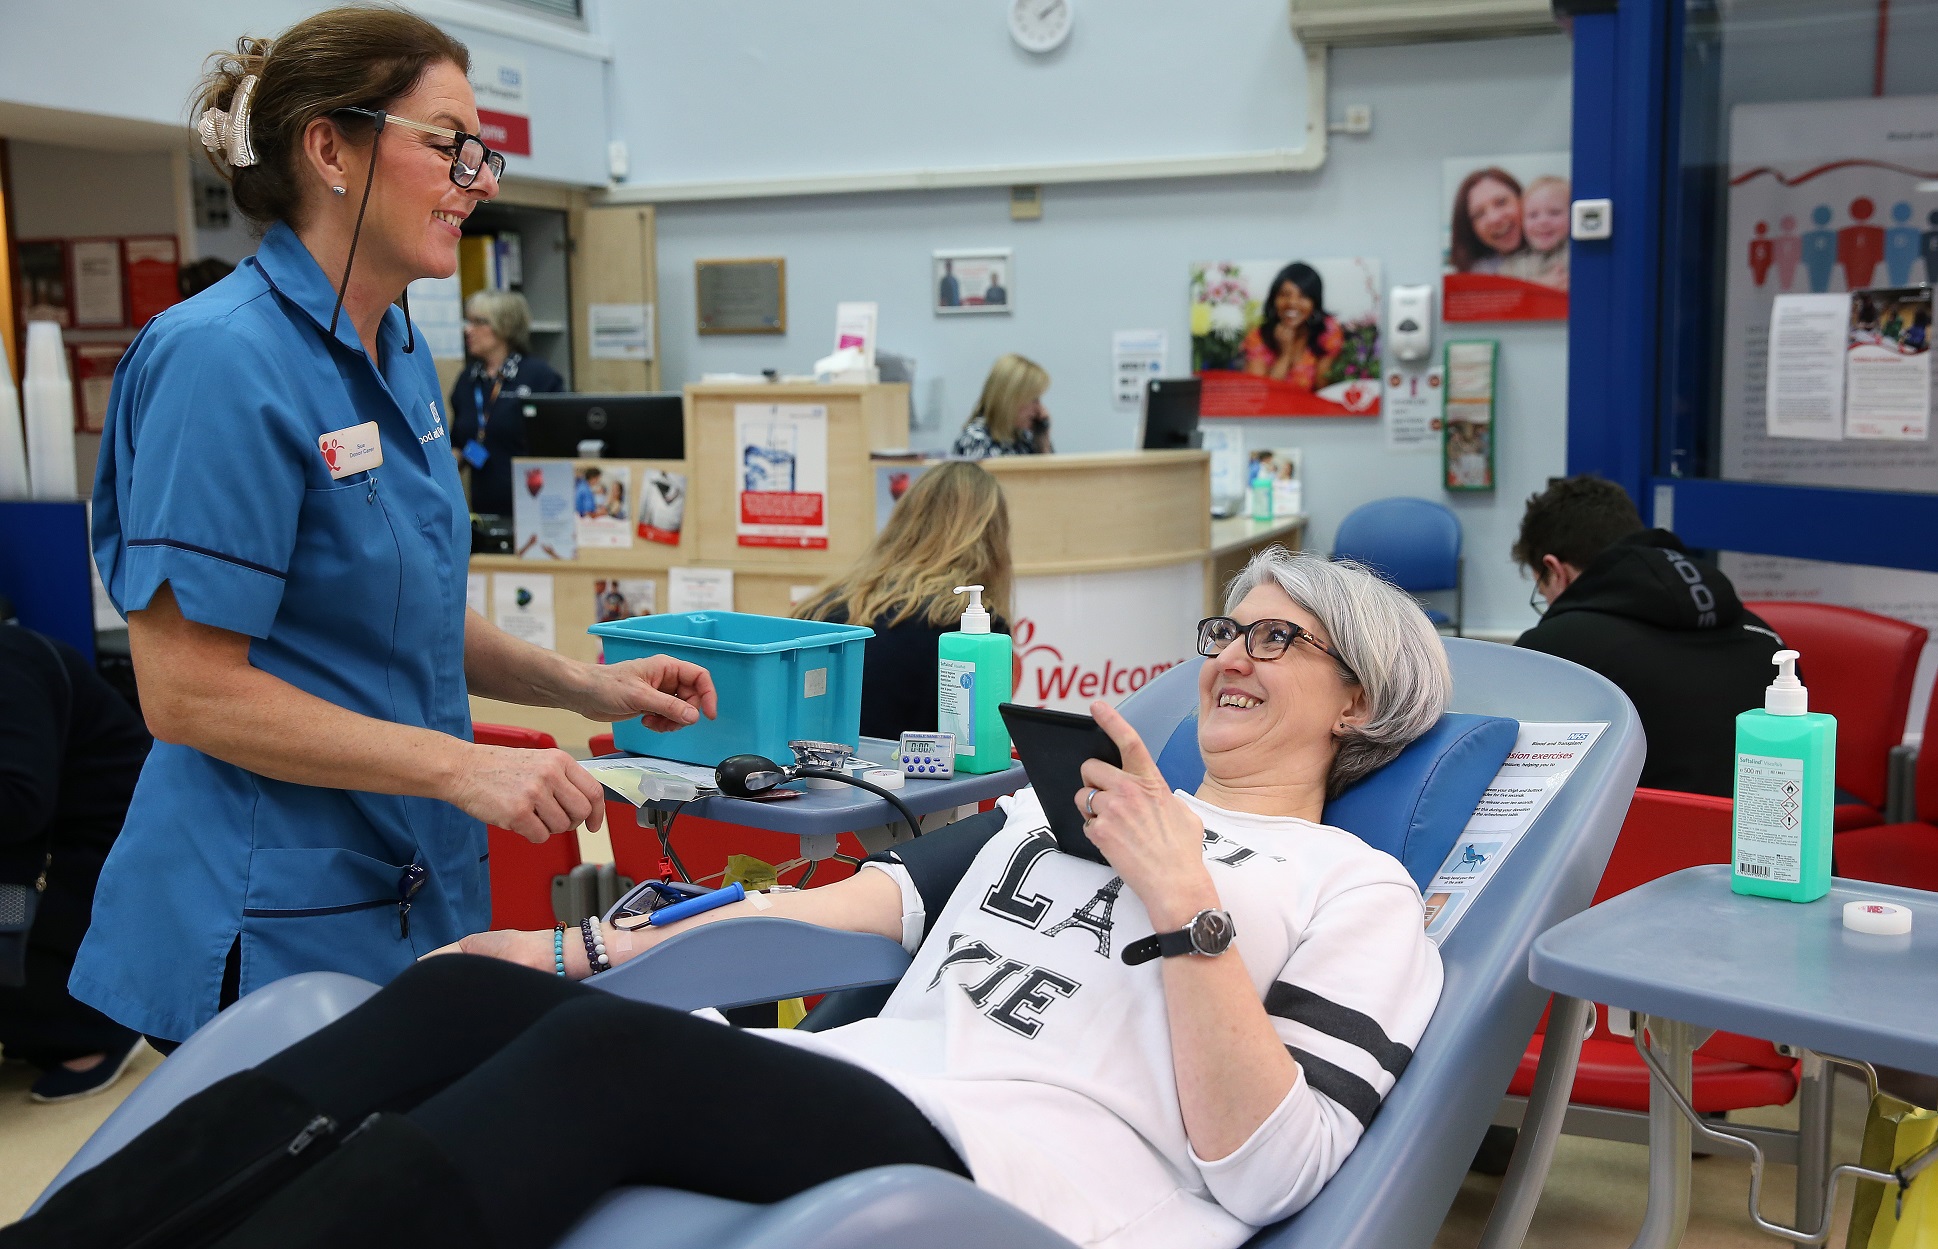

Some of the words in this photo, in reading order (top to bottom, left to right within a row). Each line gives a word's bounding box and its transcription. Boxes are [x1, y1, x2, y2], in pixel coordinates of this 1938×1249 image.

[350, 450, 362, 458] Donor
[1036, 658, 1186, 700] Welcom
[1532, 751, 1574, 760] exercises
